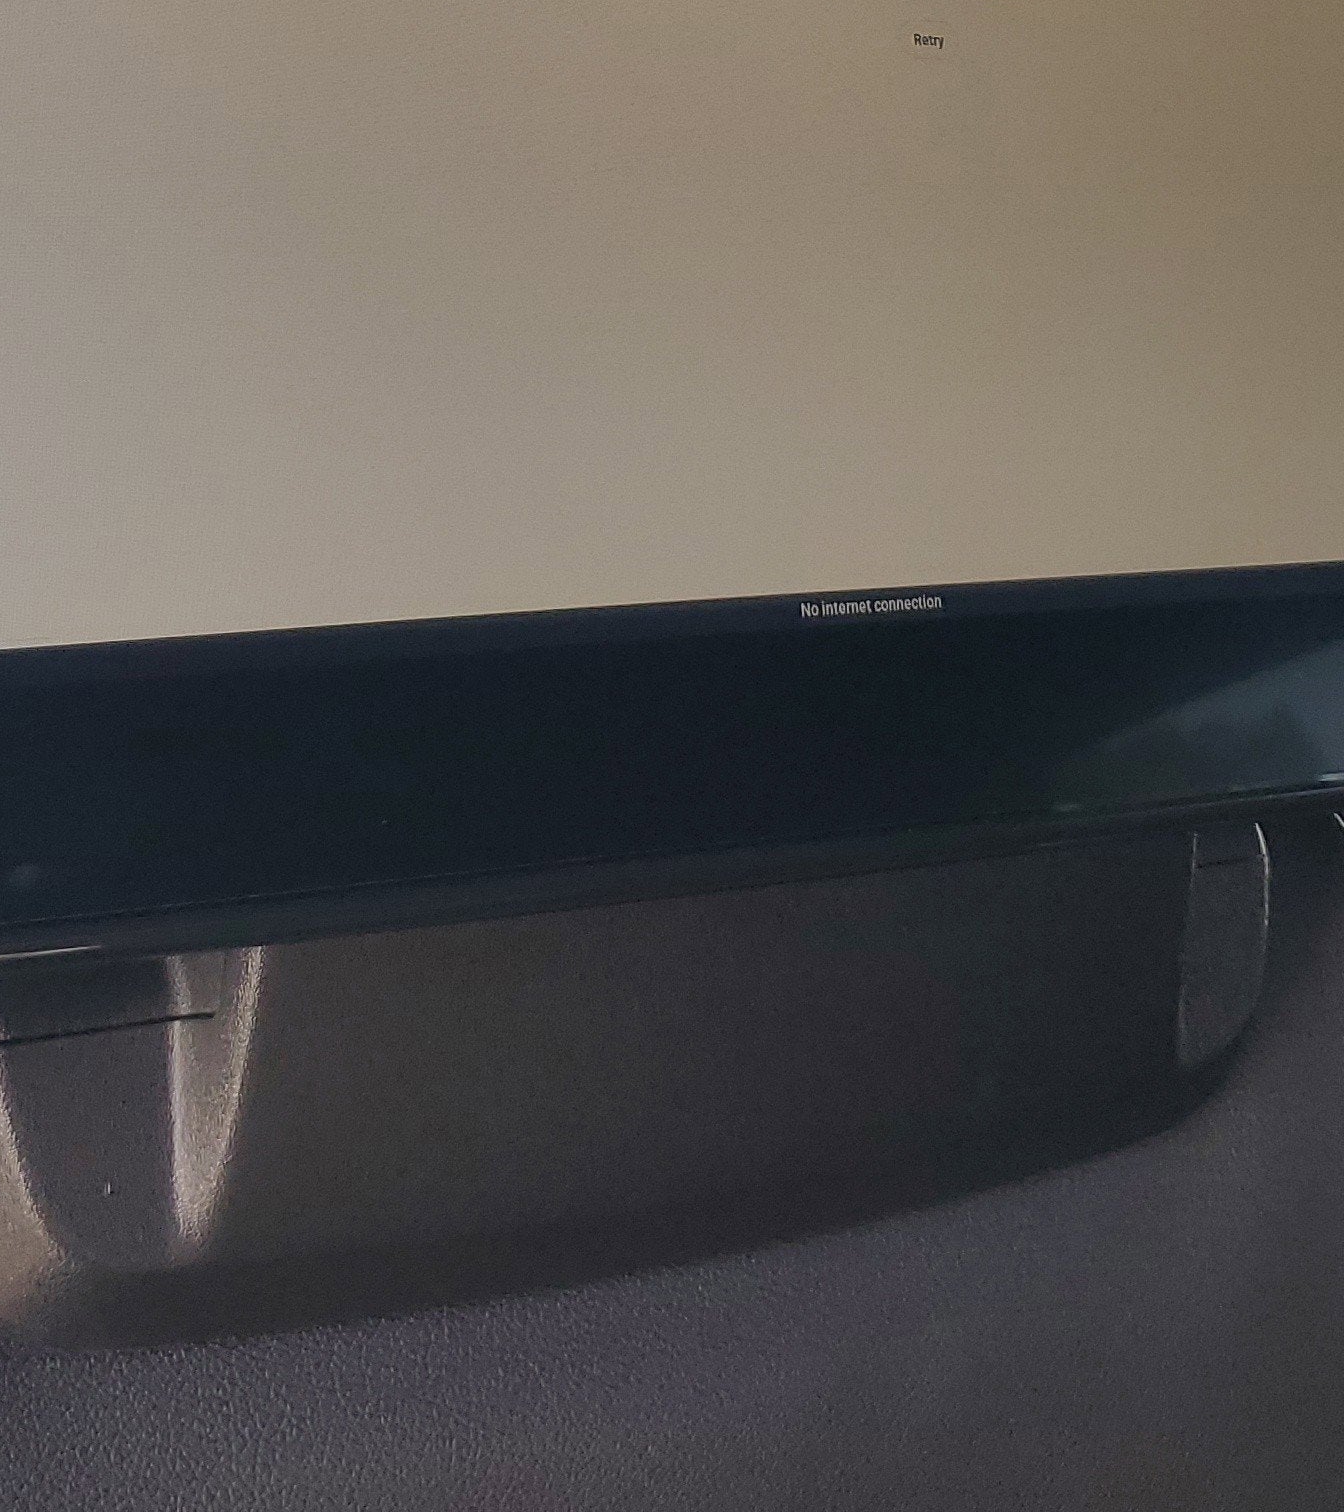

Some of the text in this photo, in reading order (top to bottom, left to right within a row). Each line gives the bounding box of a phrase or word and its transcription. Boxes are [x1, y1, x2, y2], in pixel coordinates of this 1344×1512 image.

[913, 33, 944, 49] Retry
[800, 594, 943, 618] No internet connection
